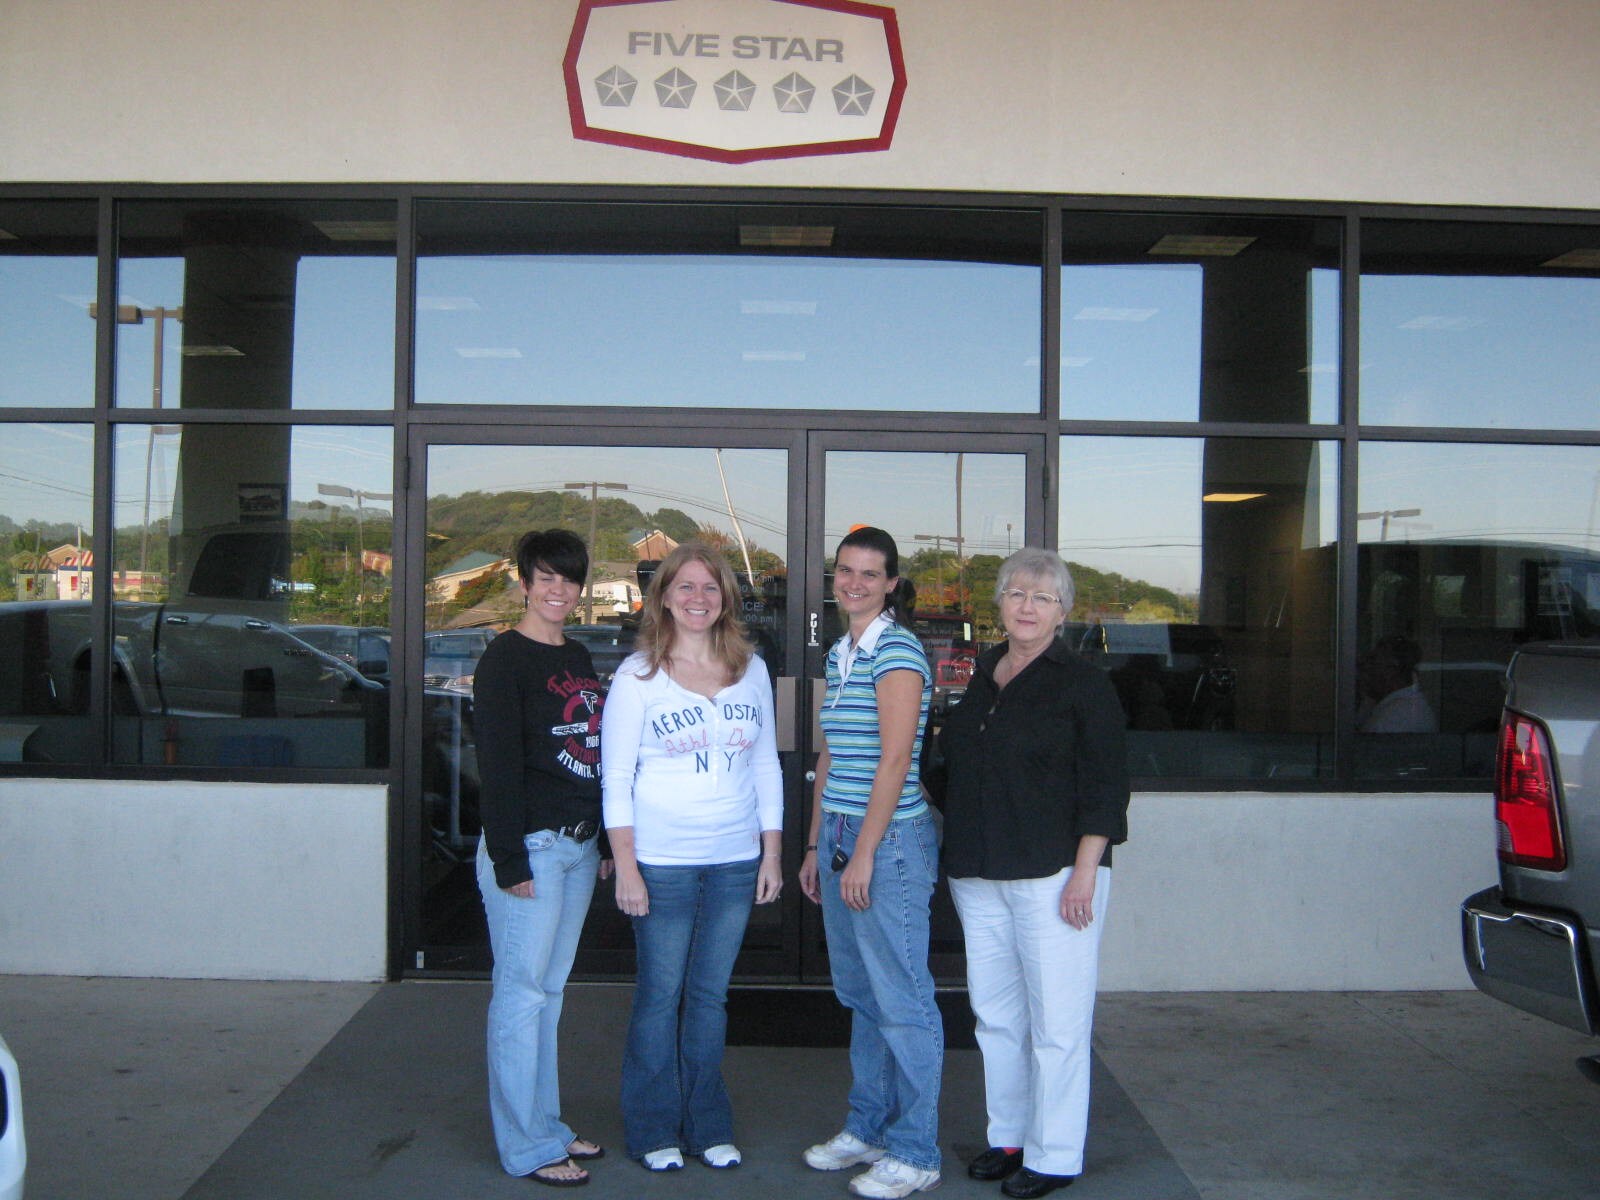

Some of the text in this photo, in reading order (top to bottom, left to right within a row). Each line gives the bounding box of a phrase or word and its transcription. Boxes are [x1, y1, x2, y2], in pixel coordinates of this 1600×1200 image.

[628, 31, 844, 63] FIVE STAR
[810, 613, 818, 643] PULL
[585, 735, 600, 749] 1966
[696, 751, 708, 773] N
[724, 751, 736, 772] Y
